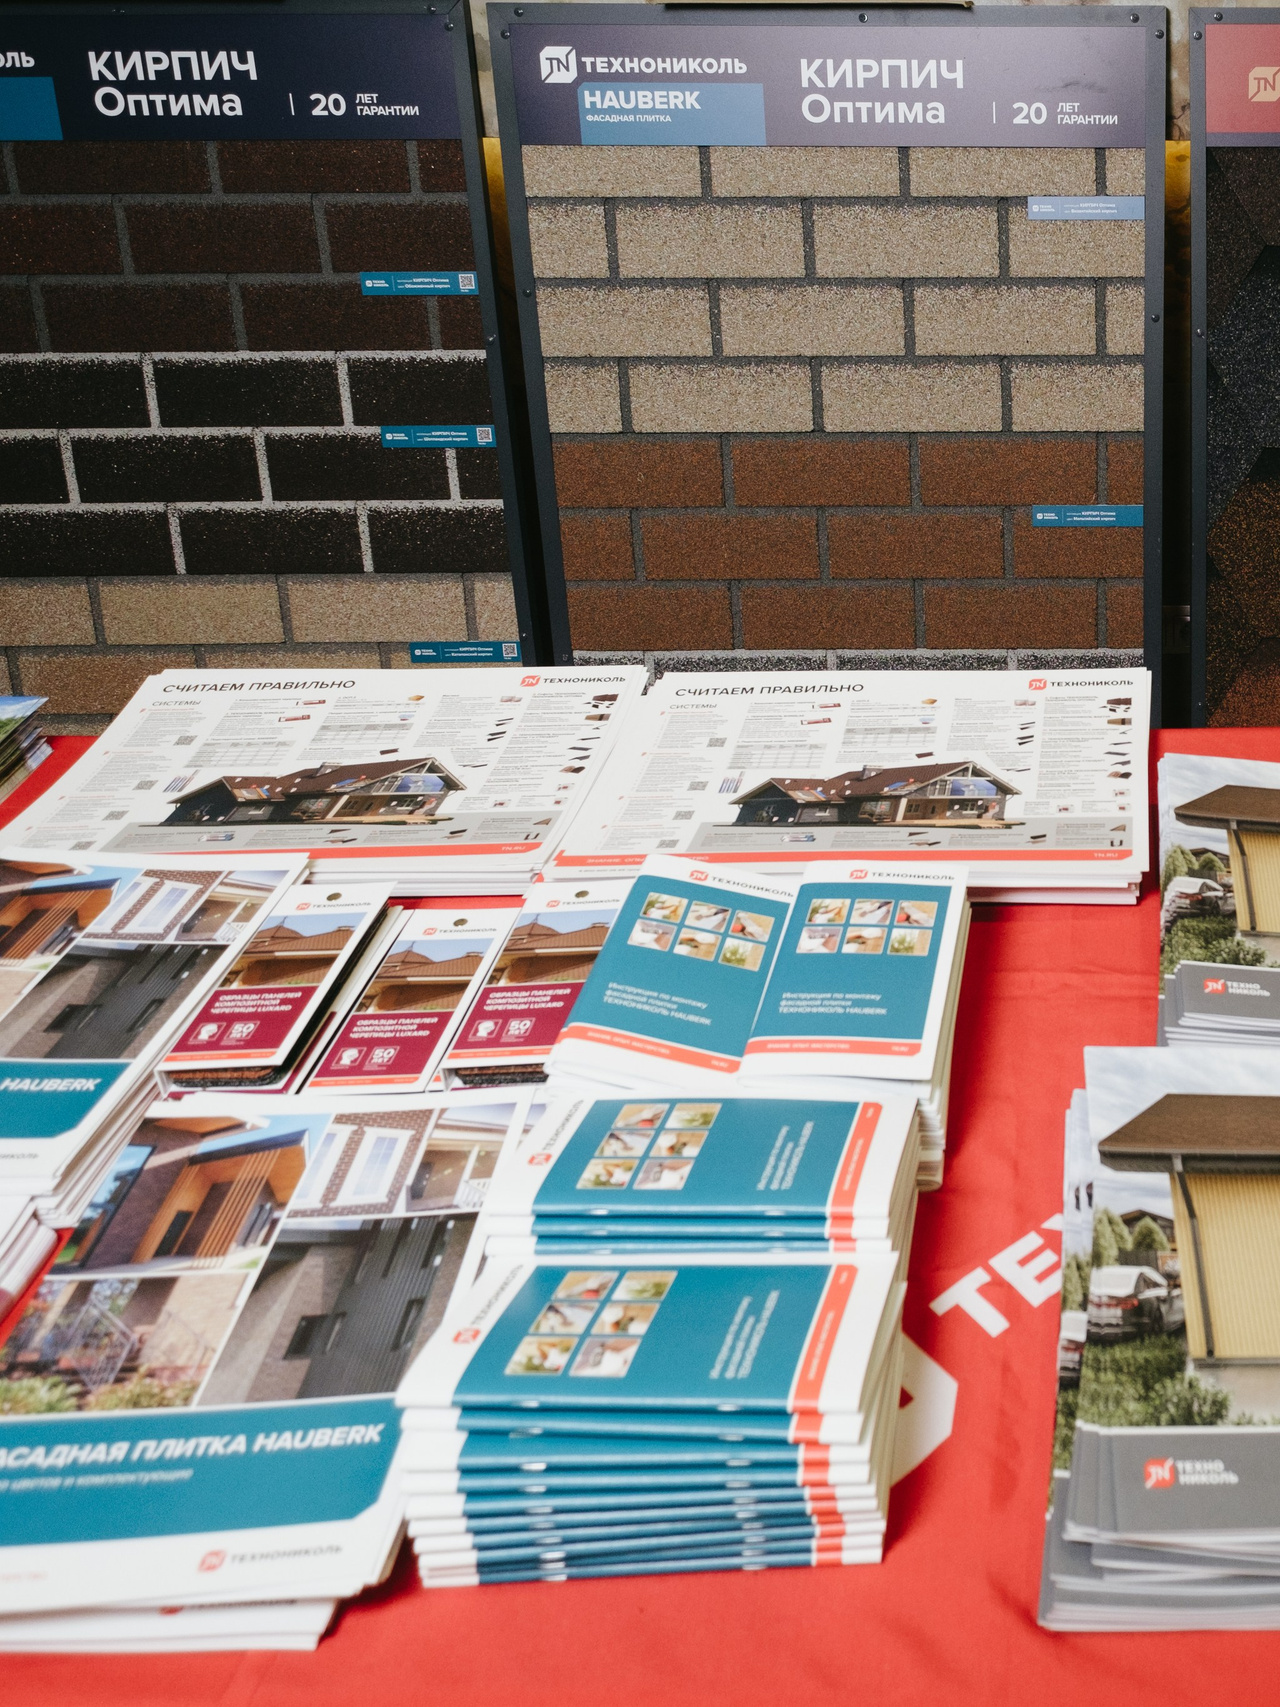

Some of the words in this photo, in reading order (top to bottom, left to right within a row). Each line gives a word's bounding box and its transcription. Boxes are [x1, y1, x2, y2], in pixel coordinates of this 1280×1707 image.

[88, 51, 258, 81] КИРПИЧ
[582, 57, 748, 74] ТЕХНОНИКОЛЬ
[800, 58, 964, 89] КИРПИЧ
[95, 86, 243, 117] Оптима
[311, 93, 346, 117] 20
[355, 94, 378, 105] ЛЕТ
[584, 90, 701, 109] HAUBERK
[357, 105, 420, 116] ГАРАНТИИ
[802, 93, 945, 124] Оптима
[1012, 102, 1048, 125] 20
[1057, 102, 1080, 113] ЛЕТ
[586, 114, 635, 123] ФАСАДНАЯ
[636, 114, 672, 123] ПЛИТКА
[1057, 114, 1118, 125] ГАРАНТИИ
[162, 683, 245, 693] СЧИТАЕМ
[248, 680, 357, 692] ПРАВИЛЬНО
[543, 676, 627, 684] ТЕХНОНИКОЛЬ
[1050, 679, 1135, 688] ТЕХНОНИКОЛЬ
[675, 687, 755, 697] СЧИТАЕМ
[759, 684, 865, 695] ПРАВИЛЬНО
[152, 699, 202, 707] СИСТЕМЫ
[871, 870, 956, 881] ТЕХНОНИКОЛЬ
[710, 875, 795, 899] ТЕХНОНИКОЛЬ
[231, 1022, 256, 1033] 50
[0, 1077, 103, 1092] HAUBERK
[928, 1213, 1063, 1338] ТЕ
[130, 1434, 248, 1463] ПЛИТКА
[252, 1423, 386, 1452] HAUBERK
[1175, 1458, 1225, 1473] ТЕХНО
[1177, 1471, 1240, 1487] НИКОЛЬ
